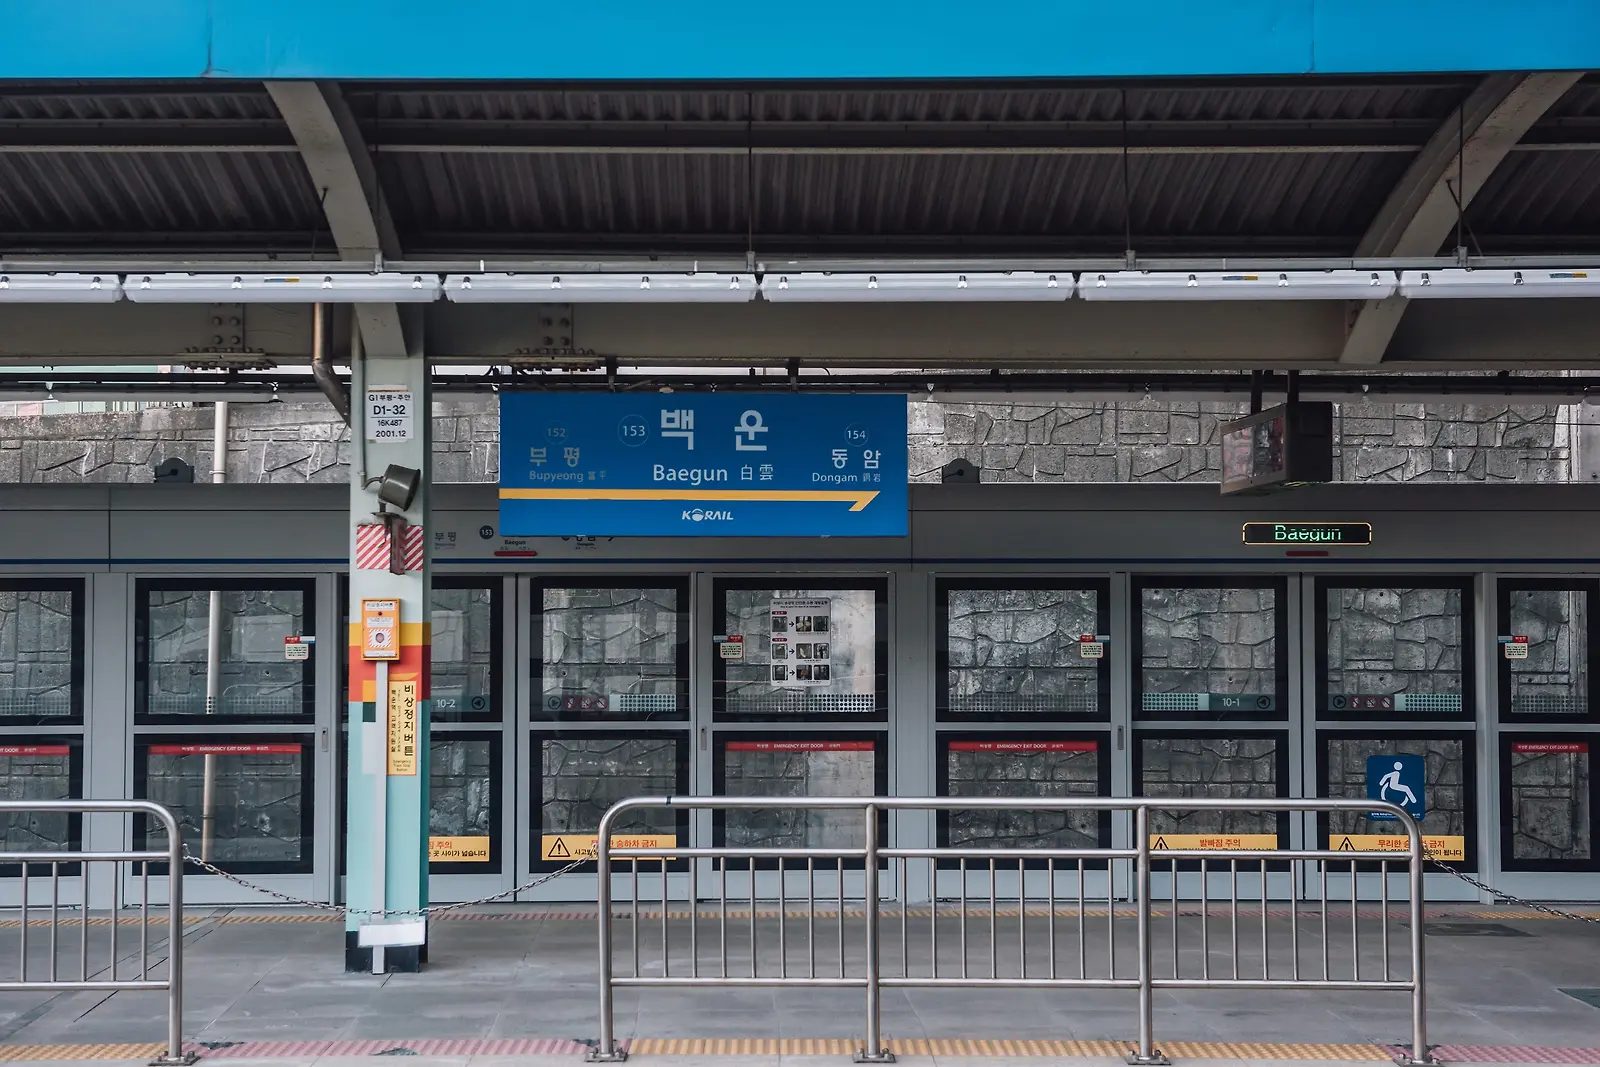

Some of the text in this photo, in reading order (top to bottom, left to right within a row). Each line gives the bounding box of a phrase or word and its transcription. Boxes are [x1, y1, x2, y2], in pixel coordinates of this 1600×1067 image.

[373, 404, 406, 415] D1-32
[377, 419, 403, 427] 16K487
[375, 430, 406, 438] 2001.12
[546, 427, 566, 438] 152
[622, 425, 646, 437] 153
[846, 429, 866, 440] 154
[529, 470, 584, 483] Bupyeong
[653, 464, 728, 486] Baegun
[811, 472, 858, 483] Dongam
[681, 508, 734, 522] KORAIL
[1275, 525, 1341, 542] Baegun
[436, 699, 456, 708] 10-2
[1222, 698, 1240, 707] 10-1
[403, 684, 415, 757] 비상정지버튼
[437, 841, 452, 850] 주의
[616, 839, 640, 848] 승하차
[641, 839, 657, 848] 금지
[1225, 839, 1241, 848] 주의
[1377, 839, 1401, 848] 무리한
[1429, 840, 1445, 849] 금지
